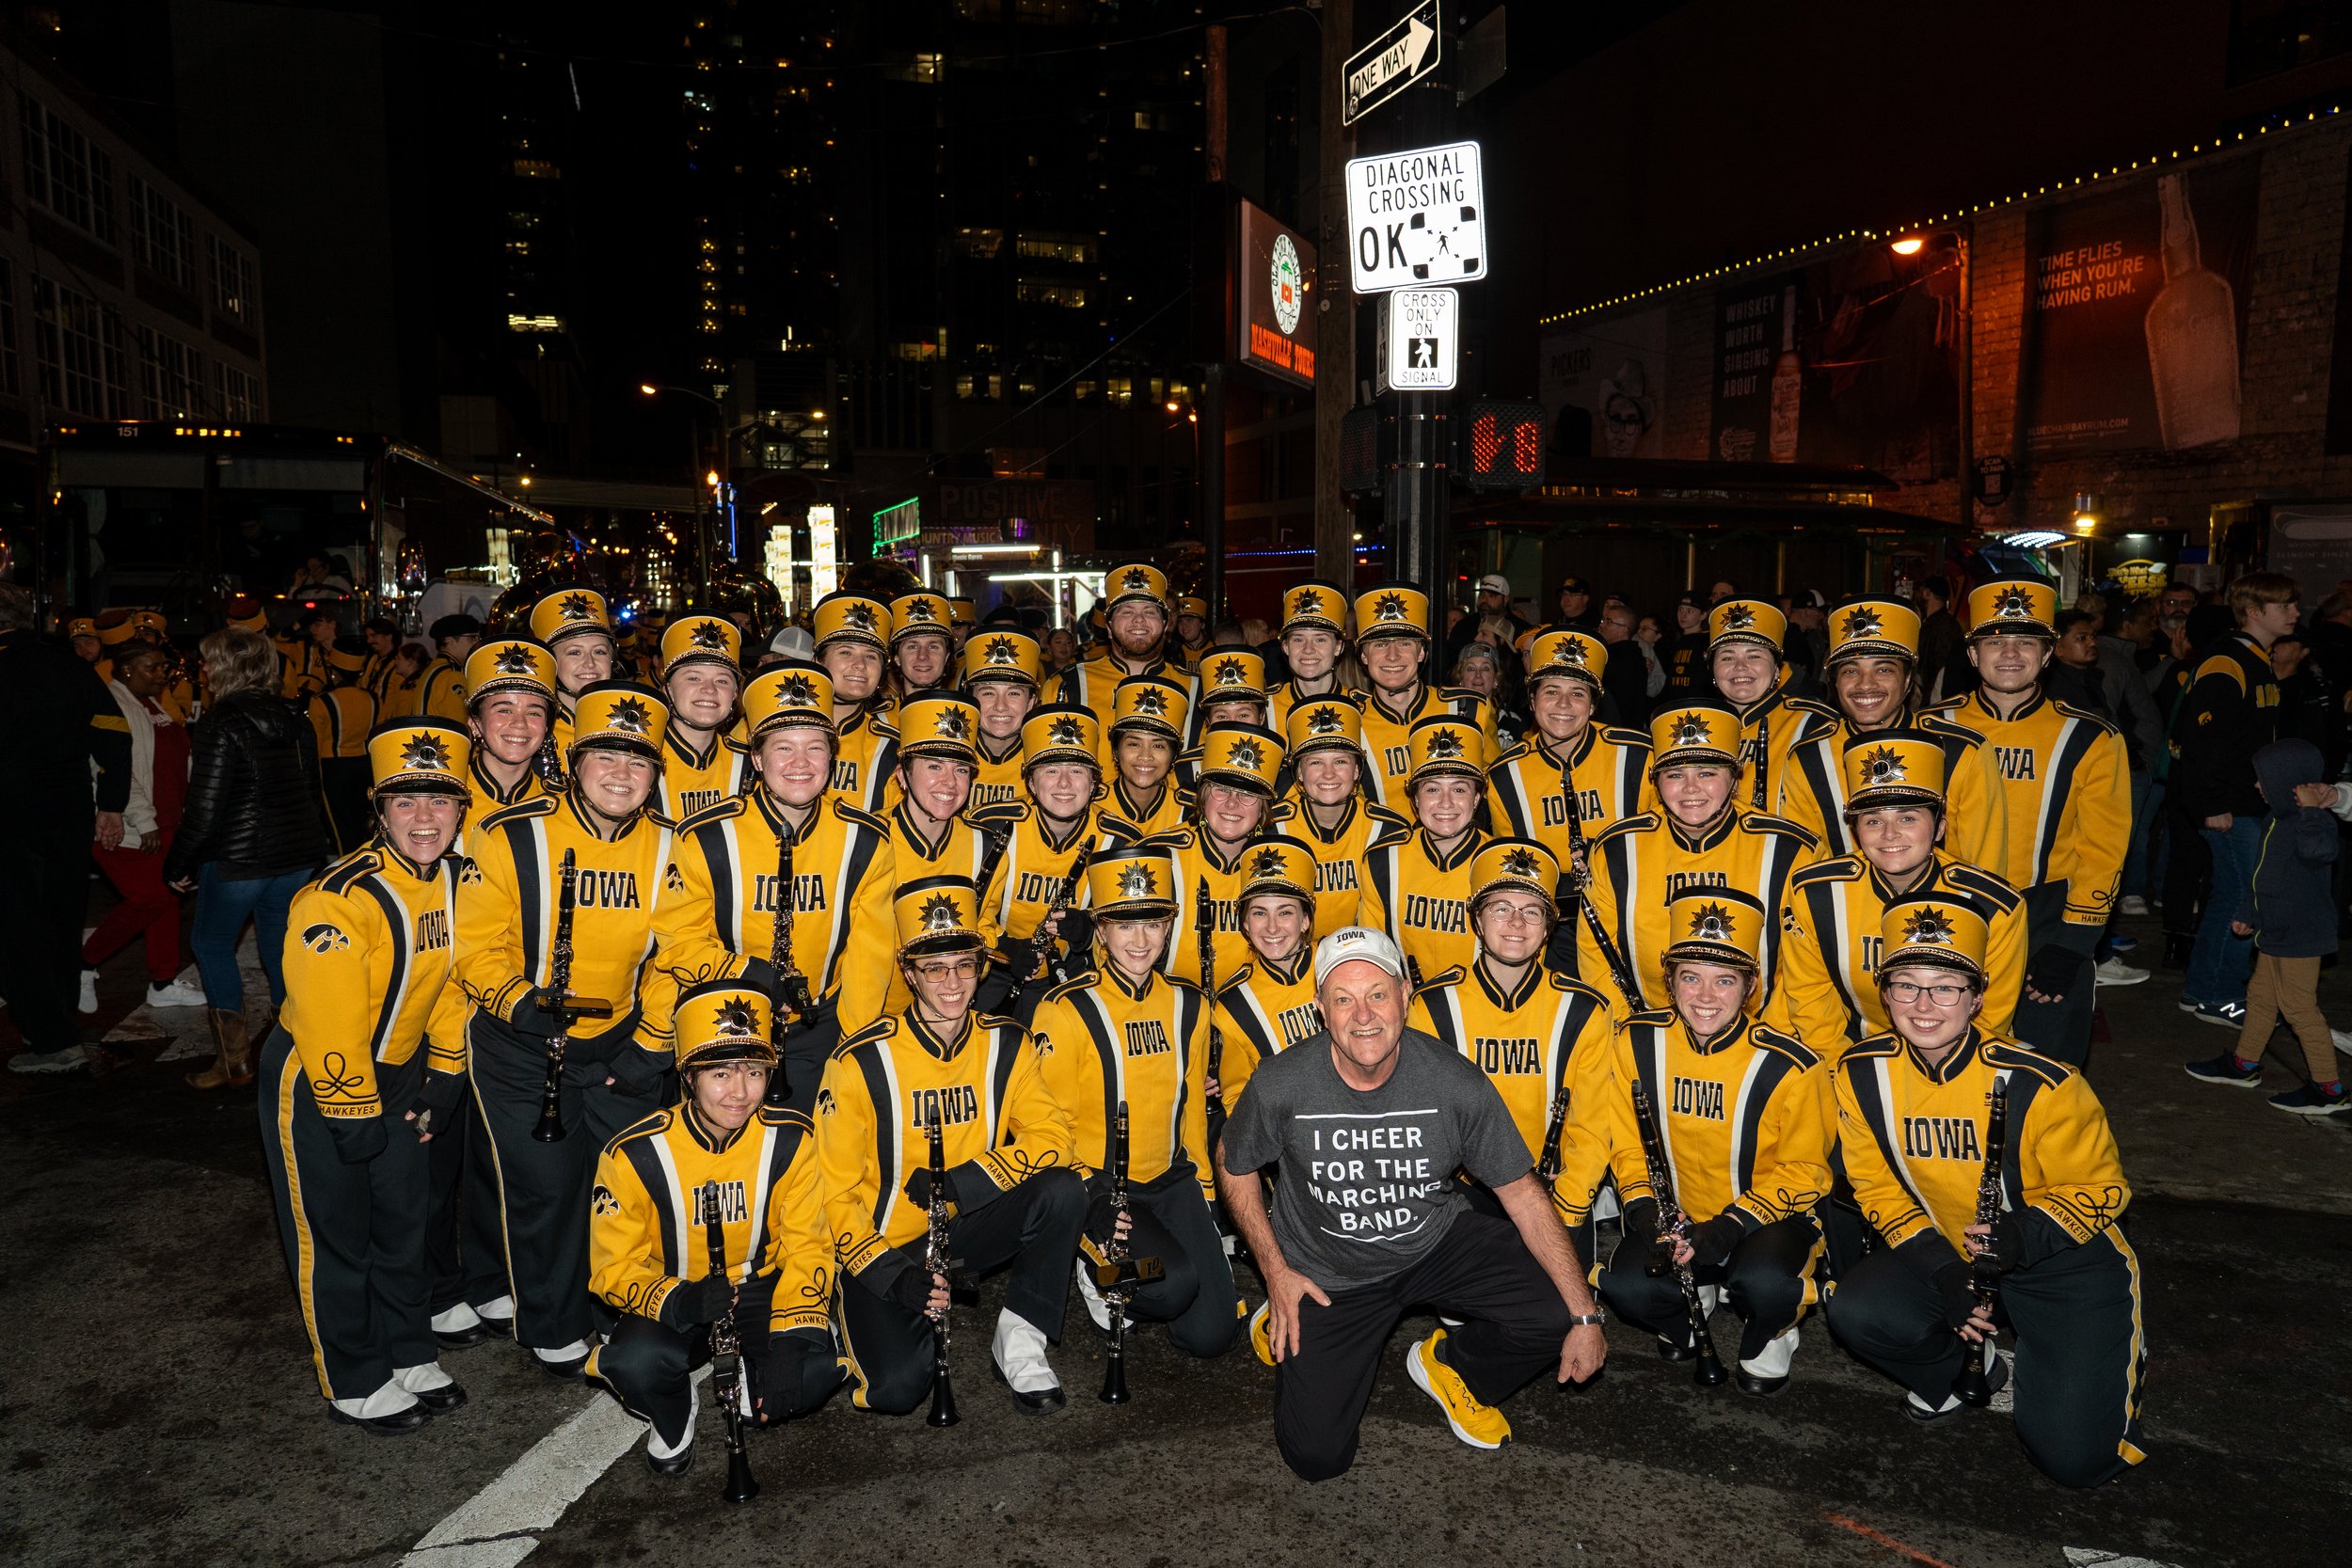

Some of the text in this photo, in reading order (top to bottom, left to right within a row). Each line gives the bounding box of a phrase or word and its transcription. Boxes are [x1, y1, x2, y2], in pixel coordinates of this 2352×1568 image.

[1353, 40, 1408, 95] ONE WAY
[1366, 152, 1465, 188] DIAGONAL
[1369, 180, 1465, 214] CROSSING
[1359, 222, 1408, 273] OK
[2039, 240, 2122, 273] TIME FLIES
[2038, 255, 2145, 292] WHEN YOU'RE
[1403, 293, 1446, 308] CROSS
[1725, 294, 1776, 324] WHISKEY
[2036, 278, 2137, 311] HAVING RUM.
[1406, 309, 1441, 322] ONLY
[1415, 323, 1433, 336] ON
[1251, 324, 1314, 379] NASHVILLE TOURS
[1725, 324, 1763, 349] WORTH
[1551, 347, 1591, 379] PICKERS
[1724, 347, 1769, 373] SINGING
[1402, 372, 1443, 383] SIGNAL
[1723, 375, 1758, 399] ABOUT
[118, 425, 139, 437] 151
[963, 531, 996, 544] MUSIC
[833, 760, 858, 792] WA
[1384, 745, 1411, 777] IO
[1994, 747, 2036, 781] WA
[1541, 789, 1605, 828] IOWA
[575, 869, 640, 910] IOWA
[754, 873, 826, 912] IOWA
[1314, 859, 1359, 894] OWA
[1194, 898, 1241, 933] OW
[1405, 894, 1468, 934] IOWA
[2081, 914, 2107, 924] HAWKE
[415, 908, 451, 954] IOWA
[1336, 930, 1366, 943] IOWA
[1862, 936, 1883, 972] IO
[501, 999, 512, 1020] EYES
[1278, 1003, 1322, 1046] IOW
[1125, 1020, 1171, 1058] IOWA
[1474, 1037, 1543, 1075] IOWA
[318, 1103, 375, 1117] HAWKEYES
[911, 1085, 978, 1129] IOWA
[1672, 1075, 1725, 1121] IOWA
[1314, 1127, 1422, 1150] I CHEER
[1903, 1116, 1982, 1162] IOWA
[987, 1162, 1013, 1192] HAWKE
[1311, 1158, 1430, 1181] FOR THE
[692, 1180, 748, 1226] IWA
[1309, 1180, 1441, 1208] MARCHING
[1340, 1208, 1418, 1232] BAND.
[1751, 1203, 1774, 1225] HAWK
[2048, 1203, 2090, 1243] HAWKEYES
[1885, 1229, 1902, 1248] EYES
[850, 1249, 873, 1275] KEYES
[649, 1287, 666, 1319] KEYES
[794, 1314, 828, 1326] HAWKEY
